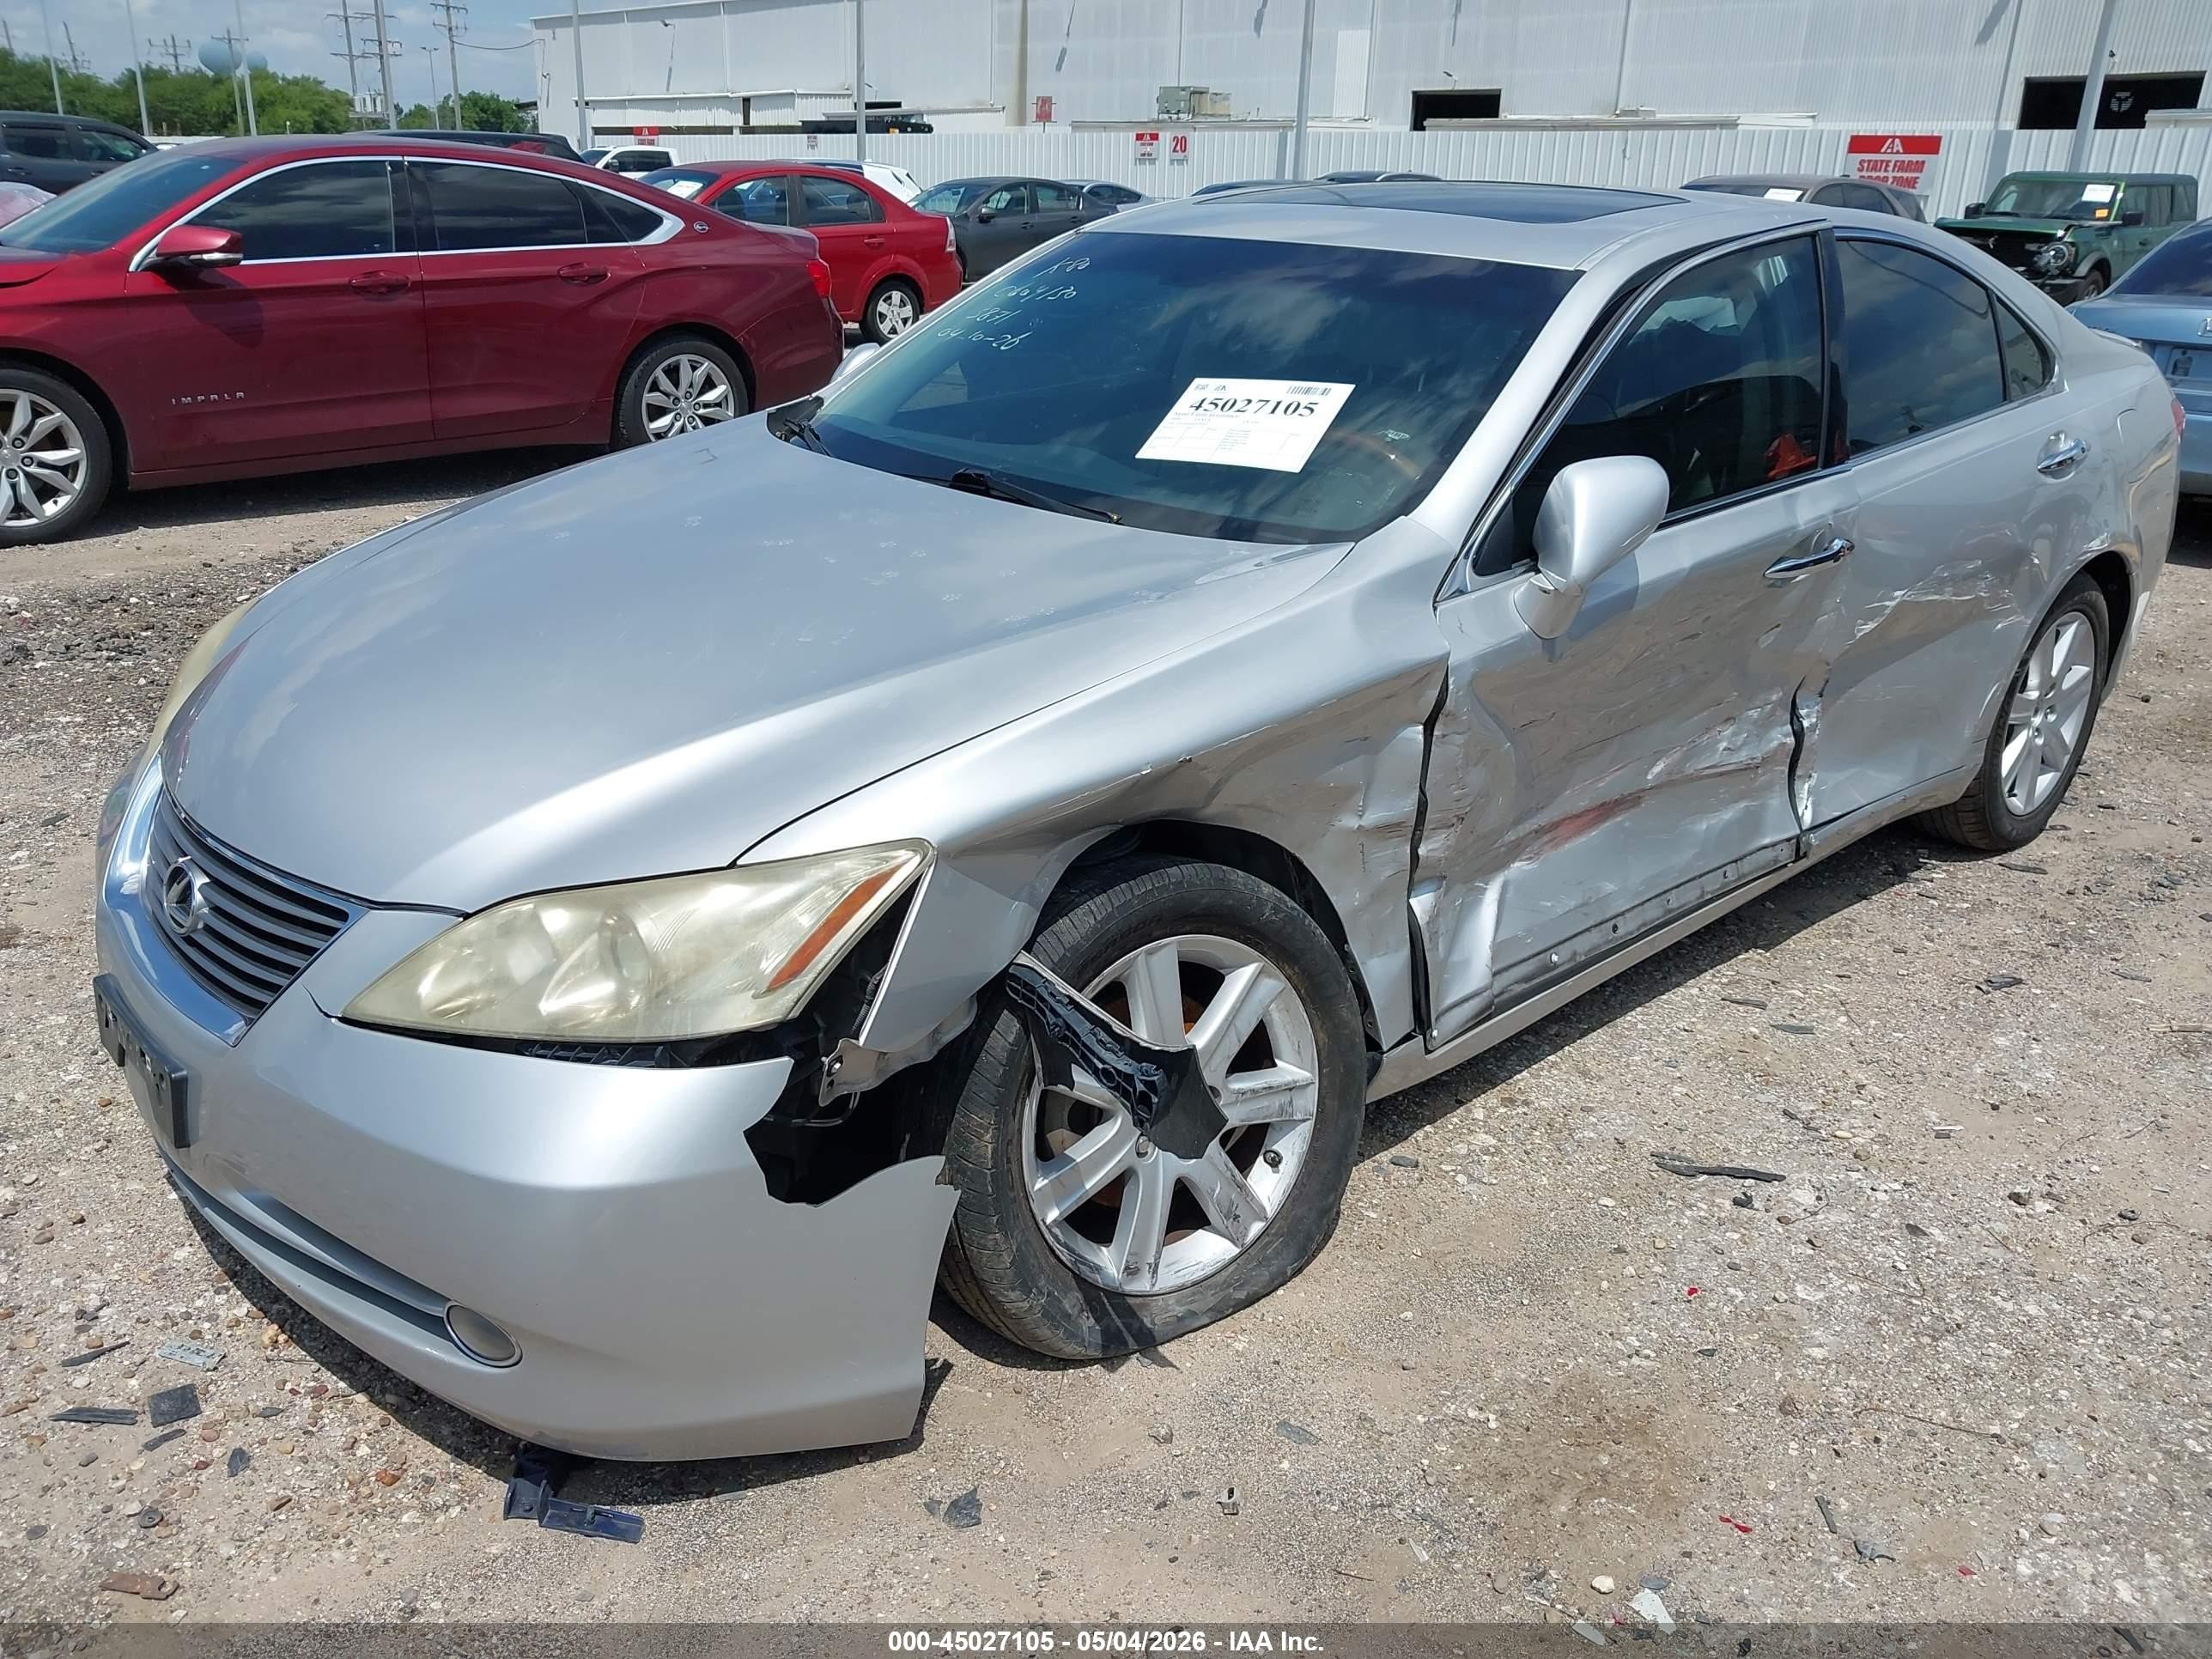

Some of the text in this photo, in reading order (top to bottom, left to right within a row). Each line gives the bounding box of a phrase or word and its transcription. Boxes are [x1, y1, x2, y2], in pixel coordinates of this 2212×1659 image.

[1172, 136, 1188, 153] 20
[1856, 158, 1926, 174] STATE FARM
[171, 391, 246, 405] IMPALA
[1188, 396, 1320, 418] 45027105
